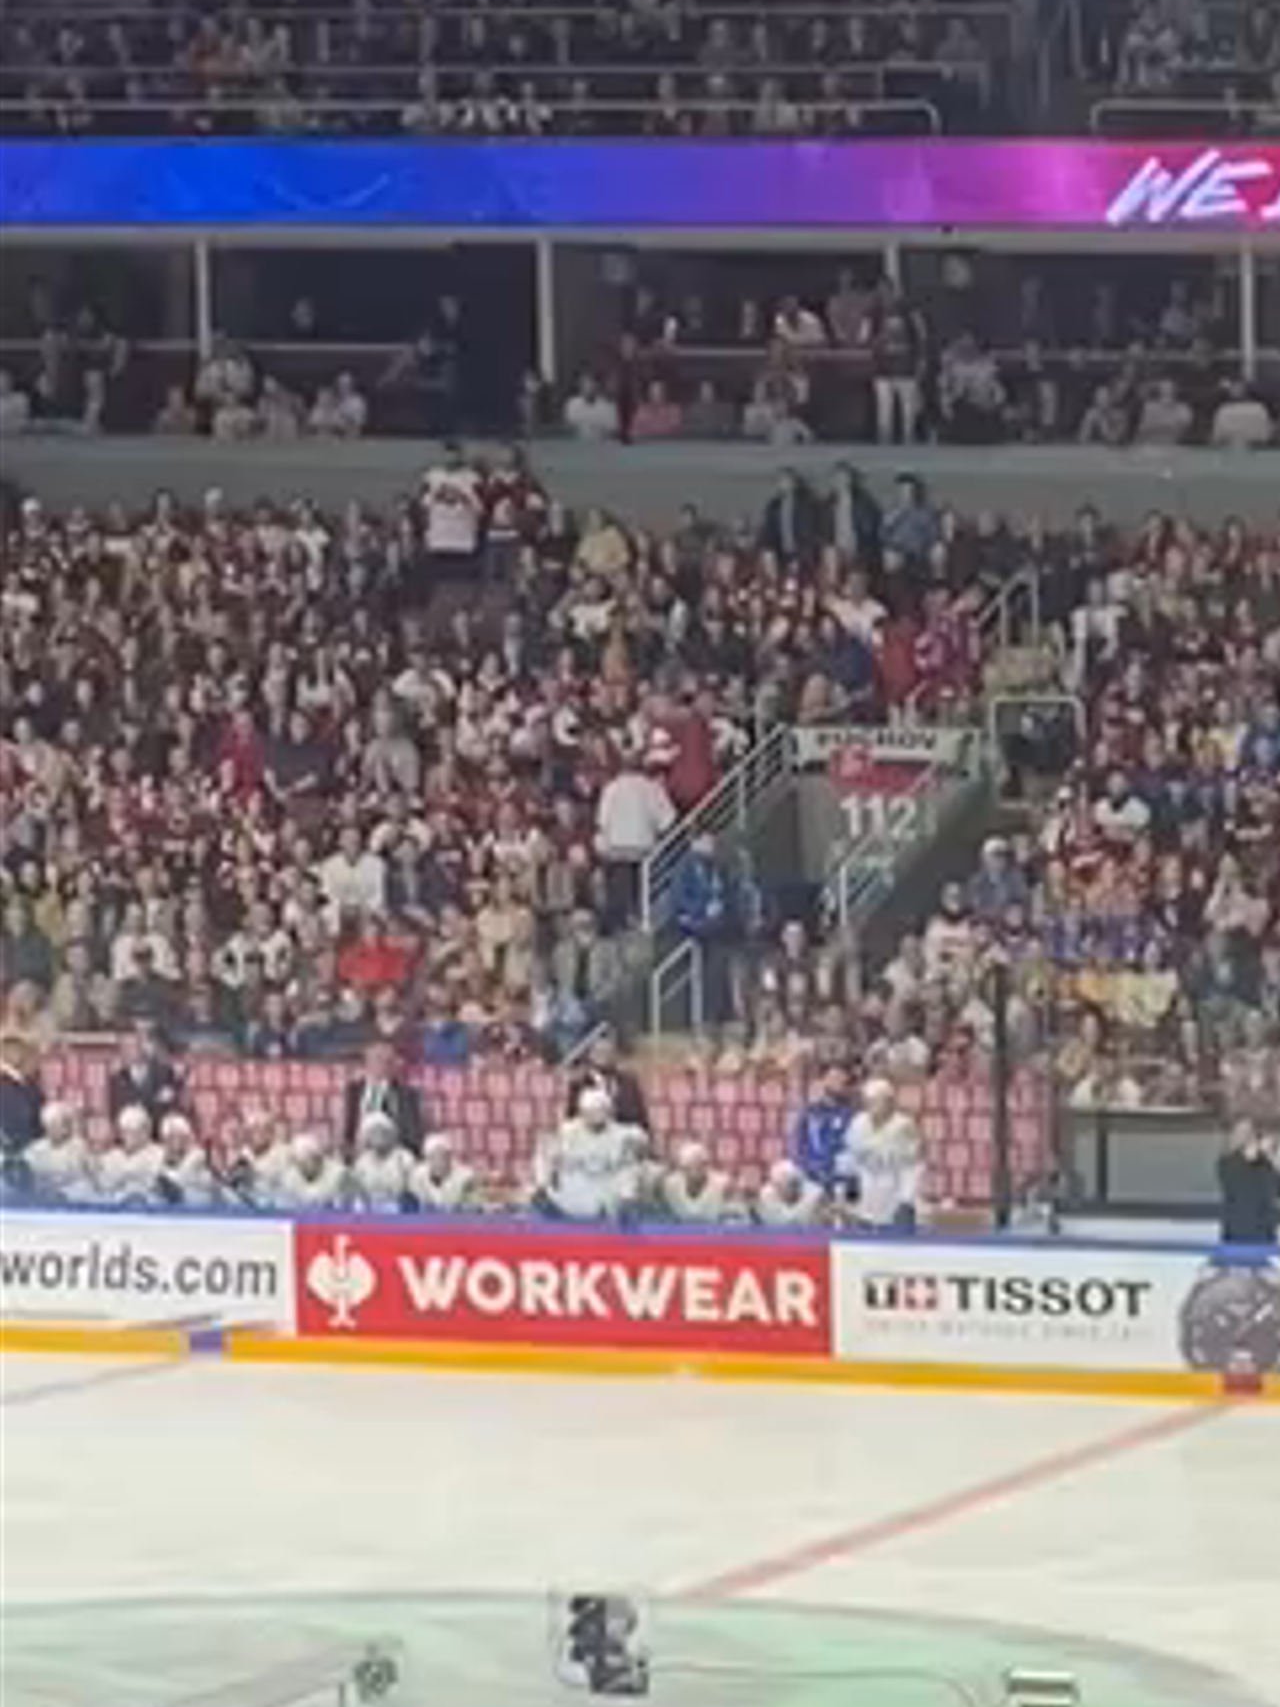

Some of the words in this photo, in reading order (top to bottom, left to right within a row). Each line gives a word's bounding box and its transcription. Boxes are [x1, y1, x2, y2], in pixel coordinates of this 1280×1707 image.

[1106, 149, 1272, 223] WE
[840, 795, 918, 841] 112
[0, 1241, 277, 1297] worlds.com
[397, 1255, 819, 1326] WORKWEAR
[946, 1276, 1153, 1318] TISSOT
